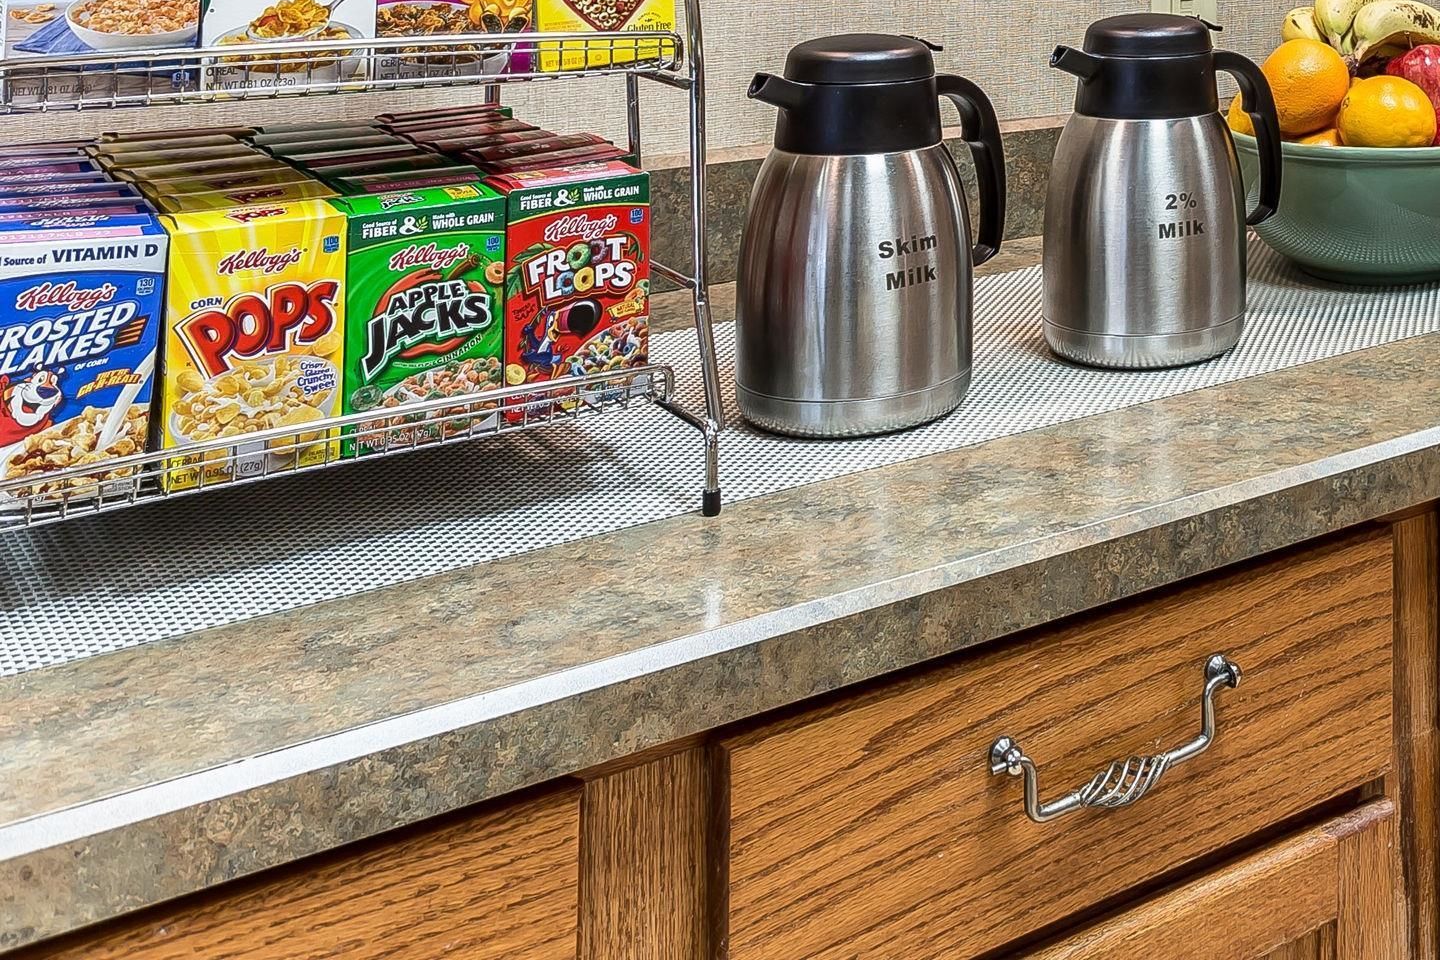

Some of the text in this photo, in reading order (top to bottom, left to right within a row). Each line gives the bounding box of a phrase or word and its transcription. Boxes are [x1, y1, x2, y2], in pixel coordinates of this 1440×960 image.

[655, 21, 672, 31] Free
[206, 66, 238, 77] CREAL
[260, 78, 272, 87] OZ
[532, 192, 546, 200] Source
[553, 188, 576, 207] &
[583, 185, 640, 202] WHOLE GRAIN
[1164, 192, 1198, 211] 2%
[520, 198, 552, 210] FIBER
[375, 220, 392, 228] Source
[399, 216, 424, 235] &
[432, 212, 495, 230] WHOLE GRAIN
[544, 214, 618, 240] Kellogg's
[1158, 219, 1205, 240] Milk
[362, 226, 398, 239] FIBER
[3, 244, 159, 267] Source of VITAMIN D
[878, 233, 938, 259] Skim
[218, 248, 302, 275] Kellogg's
[389, 243, 469, 270] Kellogg's
[528, 236, 628, 286] FROOT
[543, 261, 635, 300] LOOPS
[885, 264, 937, 291] Milk
[18, 282, 116, 310] Kellogg's
[191, 297, 223, 310] CORN
[388, 281, 466, 316] APPLE
[176, 280, 339, 379] POPS
[361, 295, 490, 379] JACKS
[437, 334, 483, 364] CINNAMON
[74, 357, 109, 371] OF CORN
[297, 373, 335, 387] Crunchy
[304, 380, 336, 396] Sweet
[349, 440, 365, 451] NT
[171, 473, 188, 484] NET
[239, 460, 264, 473] (27g)
